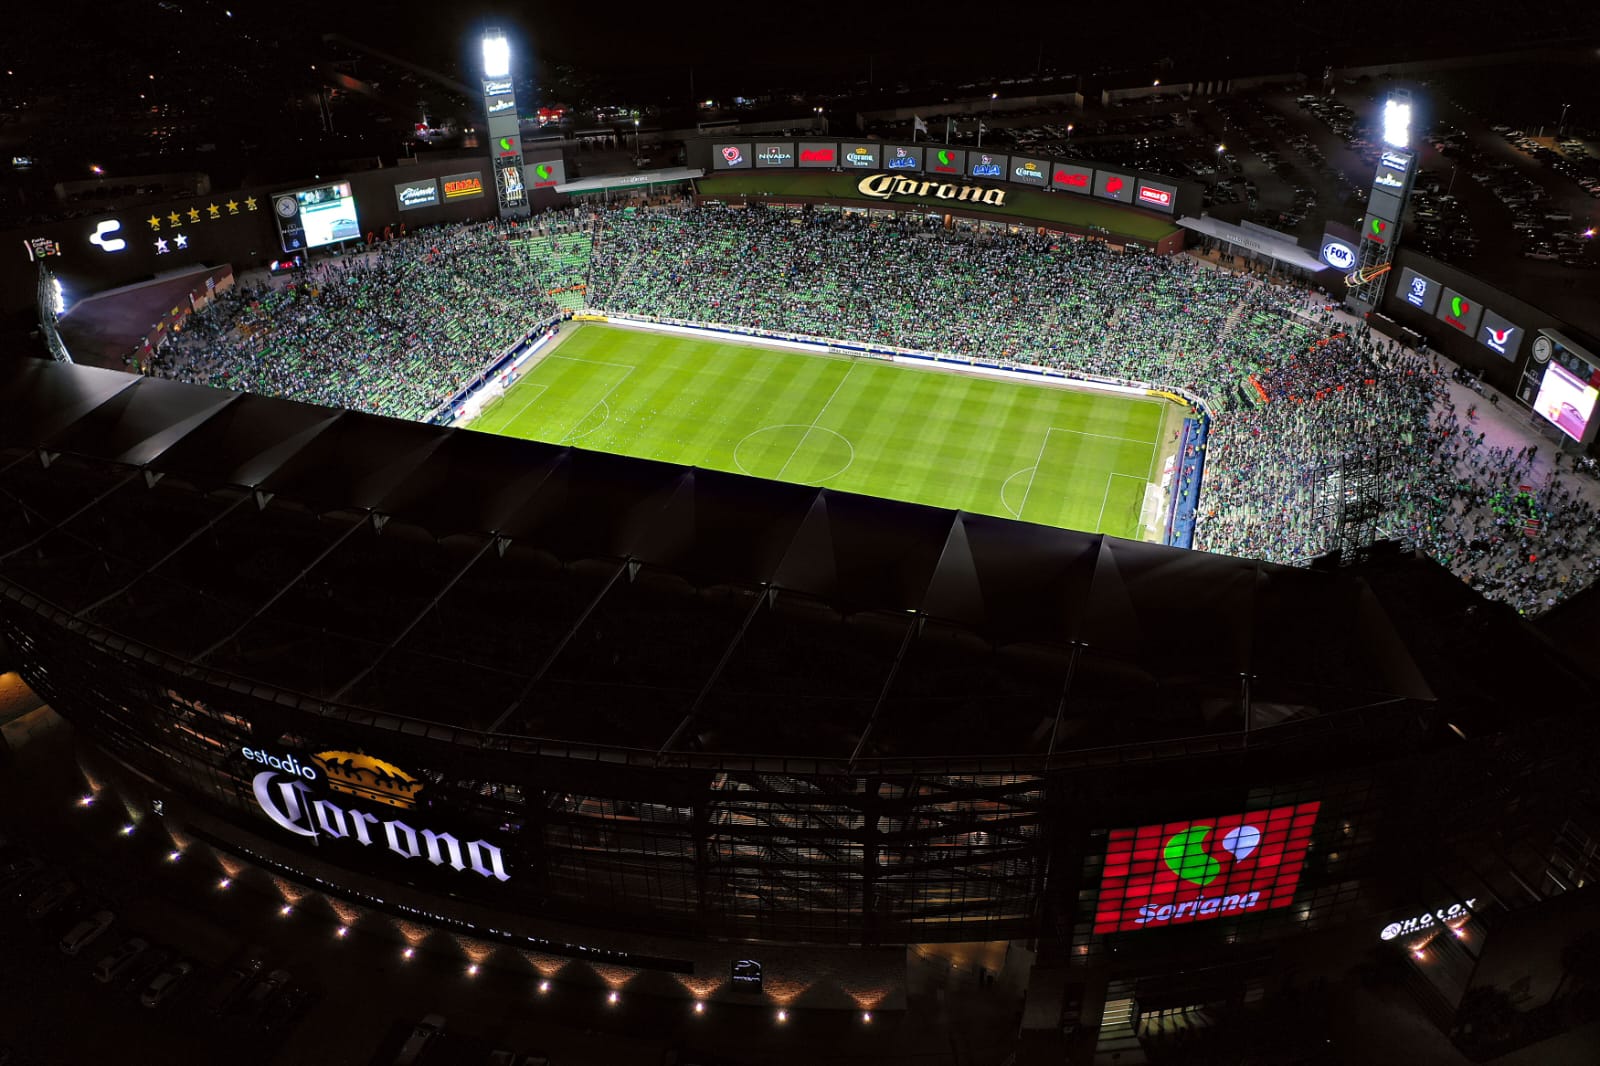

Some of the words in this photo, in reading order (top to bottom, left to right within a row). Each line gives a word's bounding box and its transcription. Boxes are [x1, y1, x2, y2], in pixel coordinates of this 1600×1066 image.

[846, 152, 874, 162] Corona
[888, 156, 916, 168] LALA
[972, 164, 1001, 176] LALA
[1015, 167, 1043, 179] Corona
[858, 173, 1007, 207] Corona
[1330, 247, 1348, 261] FOX
[241, 746, 317, 781] estadio
[252, 771, 512, 883] Corona
[1134, 891, 1261, 924] Soriana
